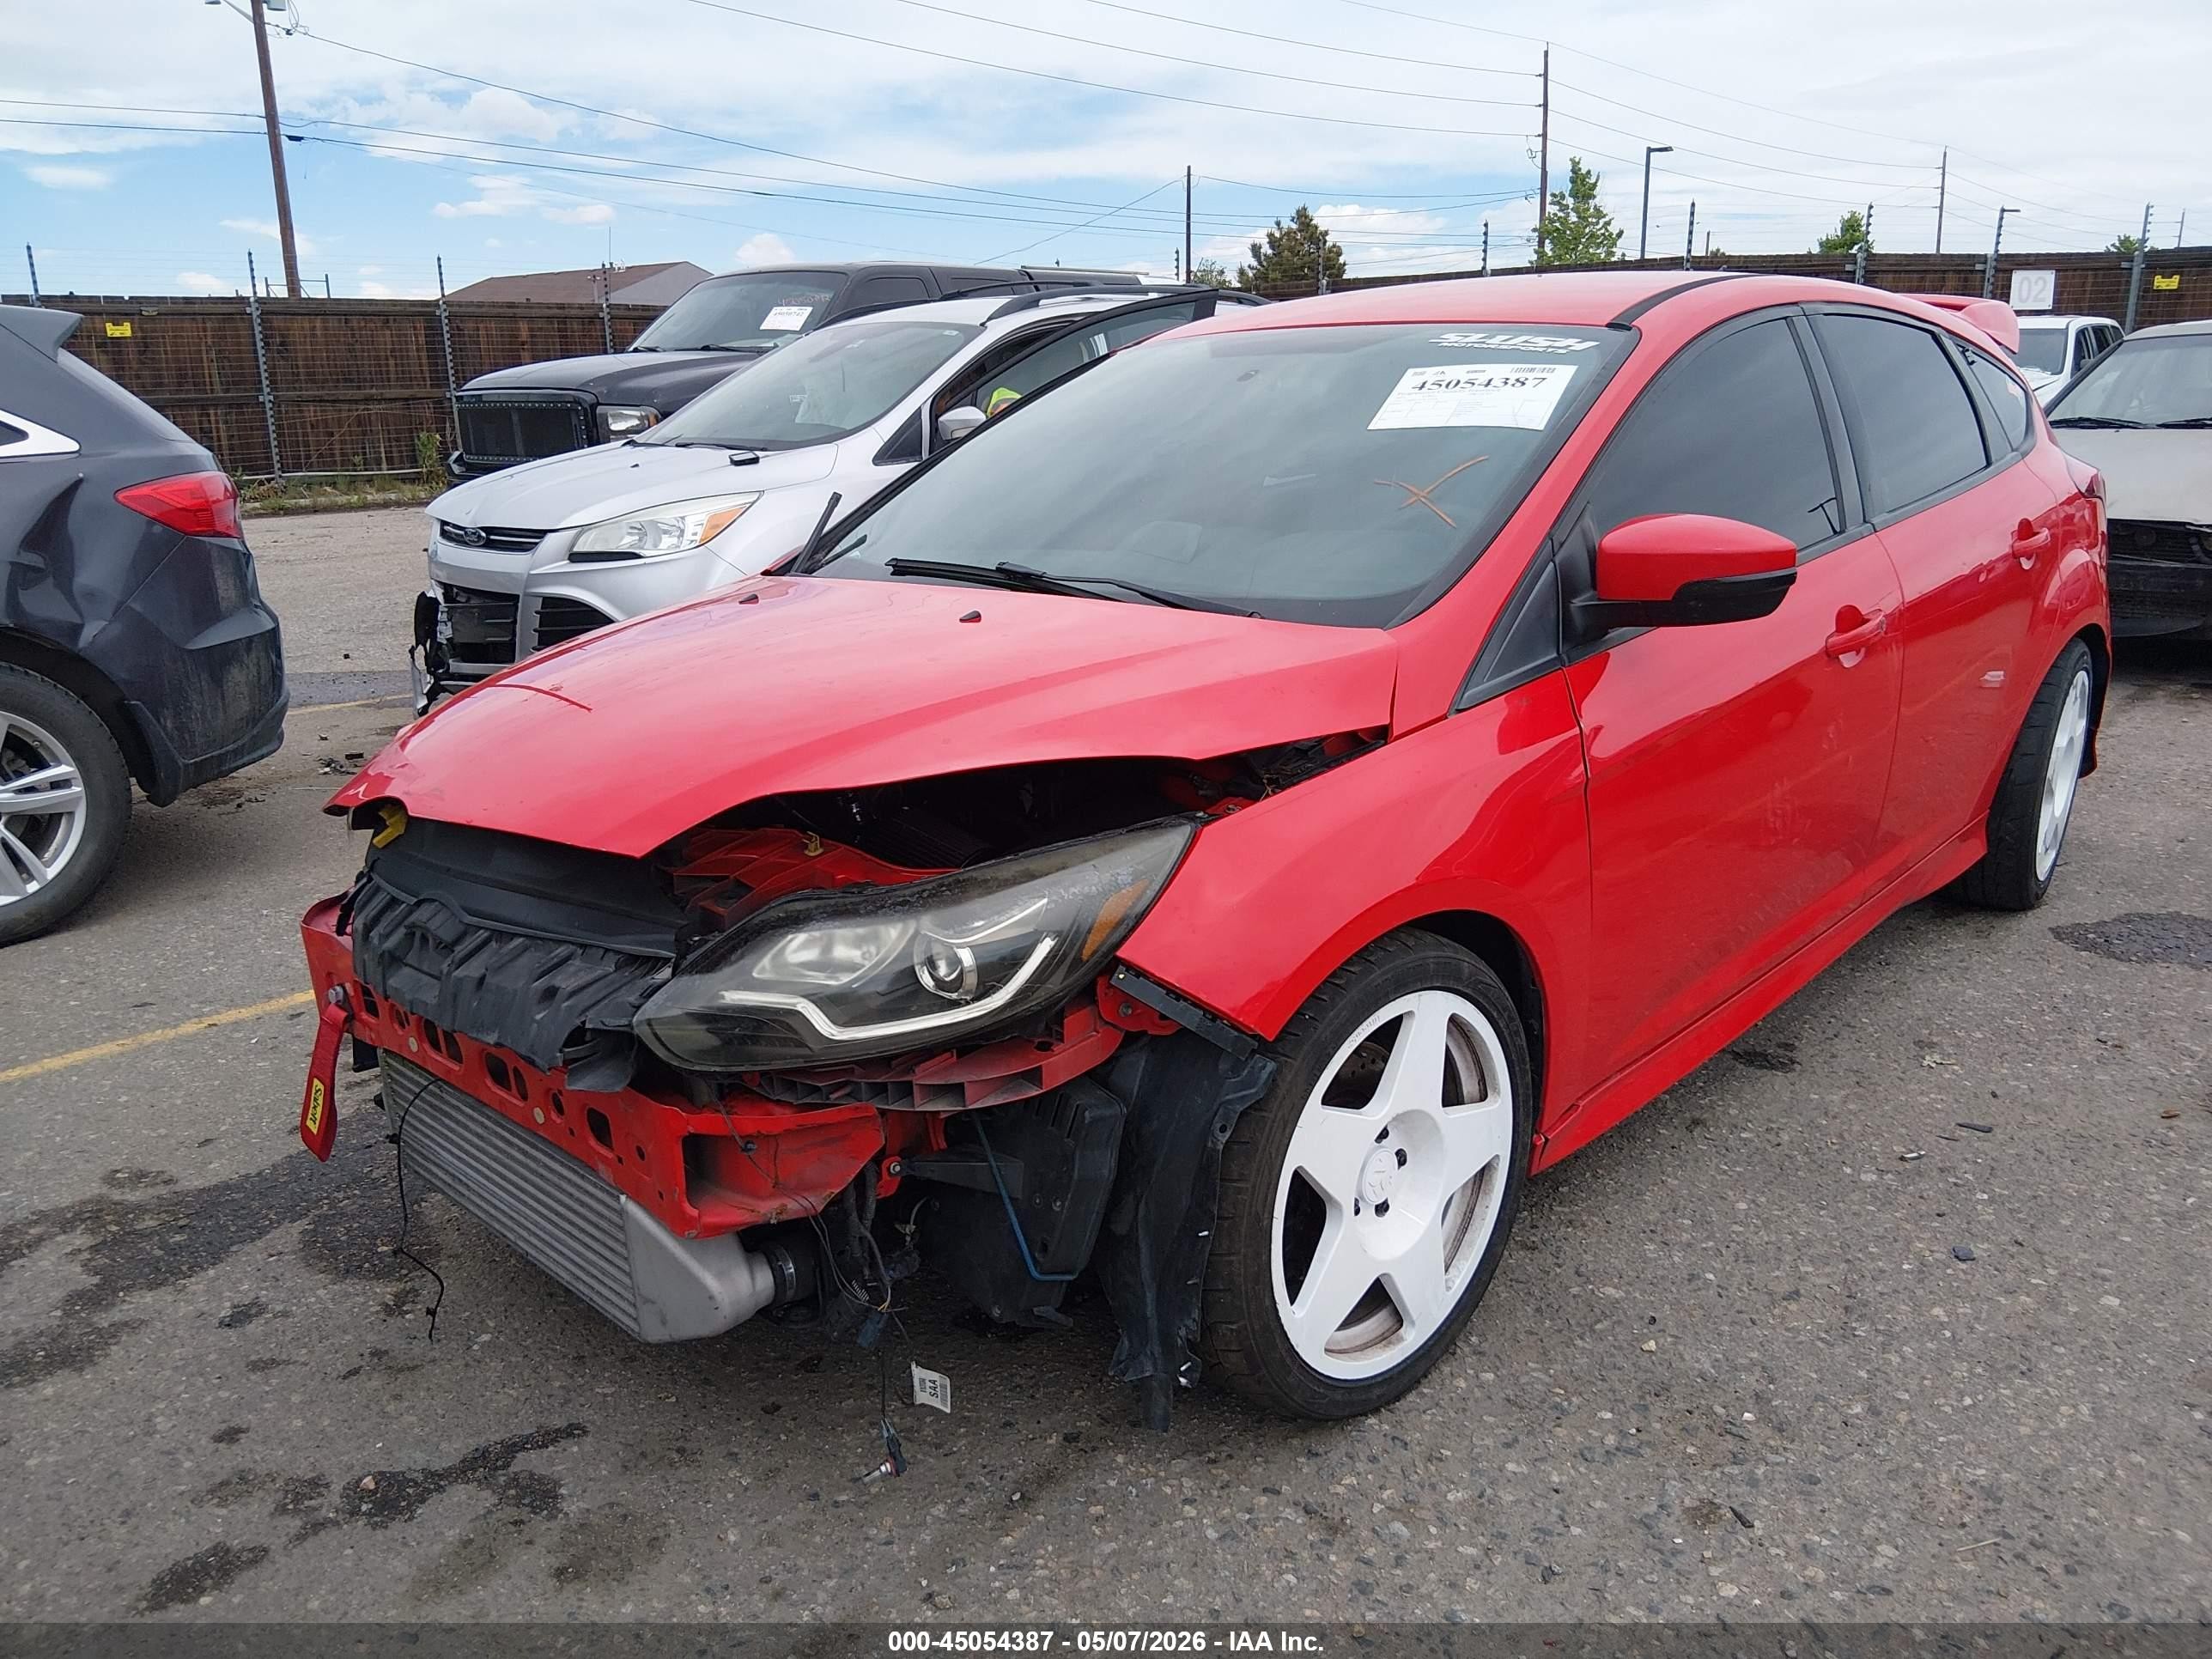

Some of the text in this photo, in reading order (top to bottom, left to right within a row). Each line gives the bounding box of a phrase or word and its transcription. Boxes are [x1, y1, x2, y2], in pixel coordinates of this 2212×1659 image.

[2018, 276, 2047, 303] 02
[1437, 343, 1571, 354] MOTORSPORTS
[1411, 377, 1547, 392] 45054387
[928, 1379, 939, 1399] SAA
